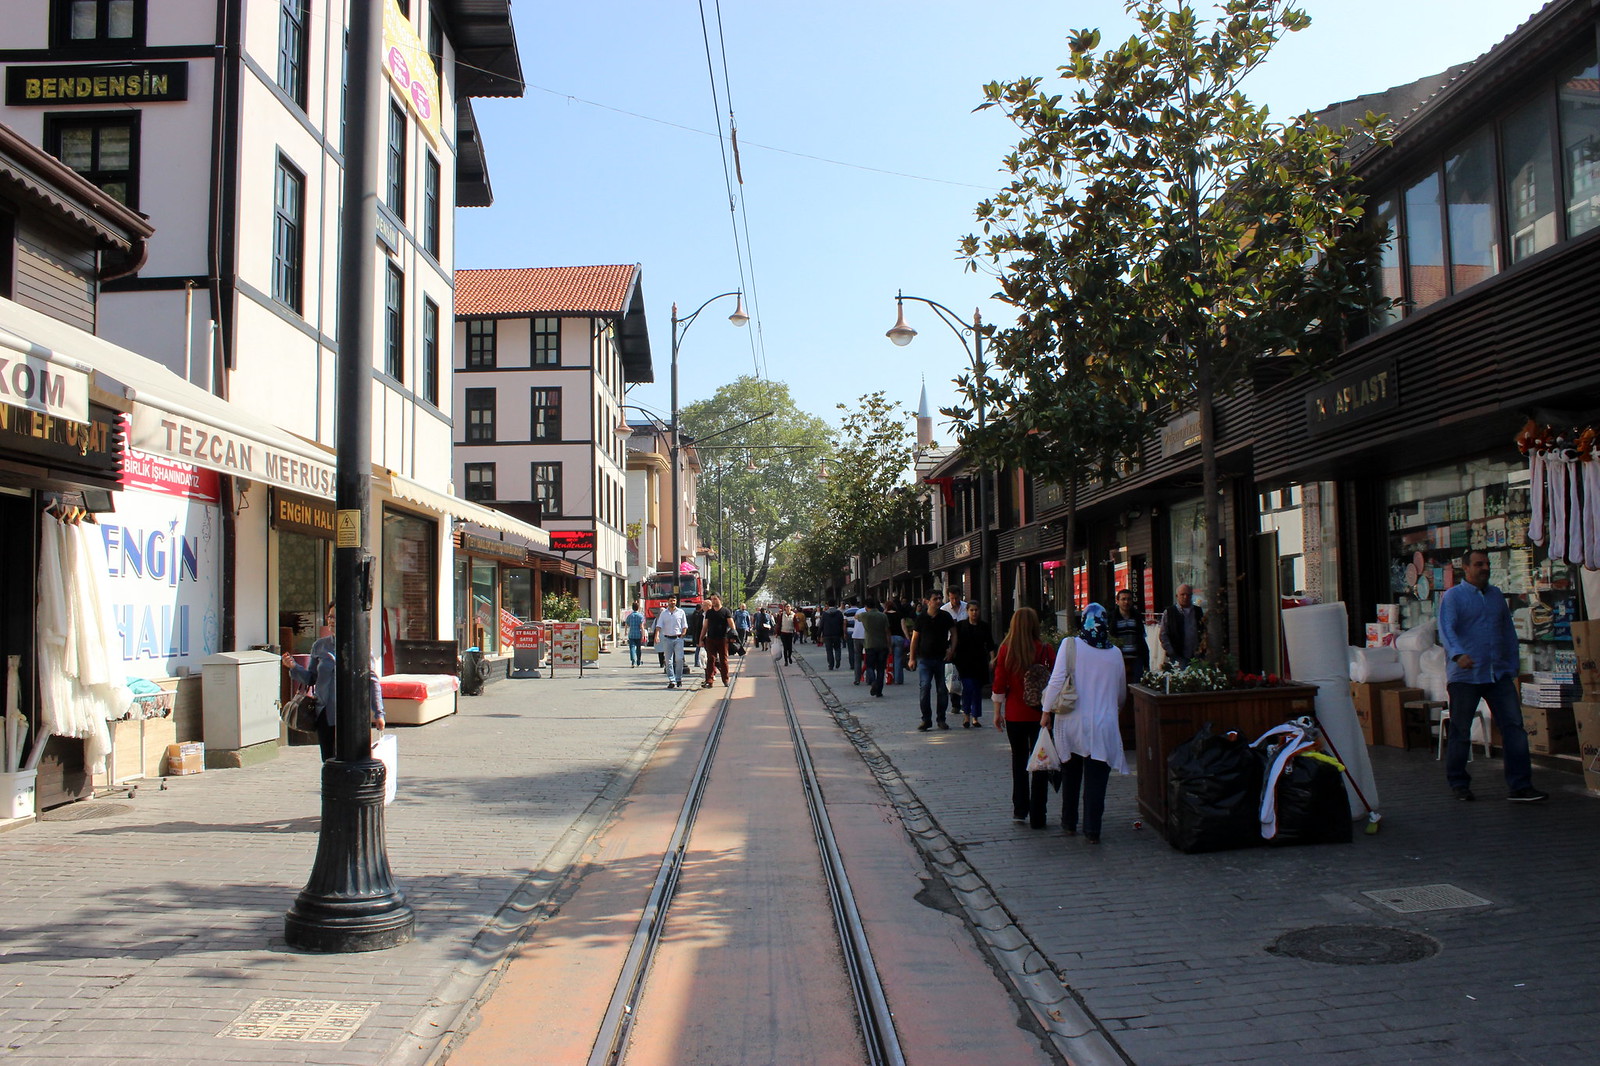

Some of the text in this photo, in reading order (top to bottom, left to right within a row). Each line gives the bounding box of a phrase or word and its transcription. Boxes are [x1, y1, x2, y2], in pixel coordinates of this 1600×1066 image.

[25, 70, 168, 99] BENDENSİN
[161, 419, 252, 472] TEZCAN
[124, 458, 151, 477] BİRLİK
[280, 500, 335, 531] ENGİN HALI
[101, 515, 199, 587] ENGİN
